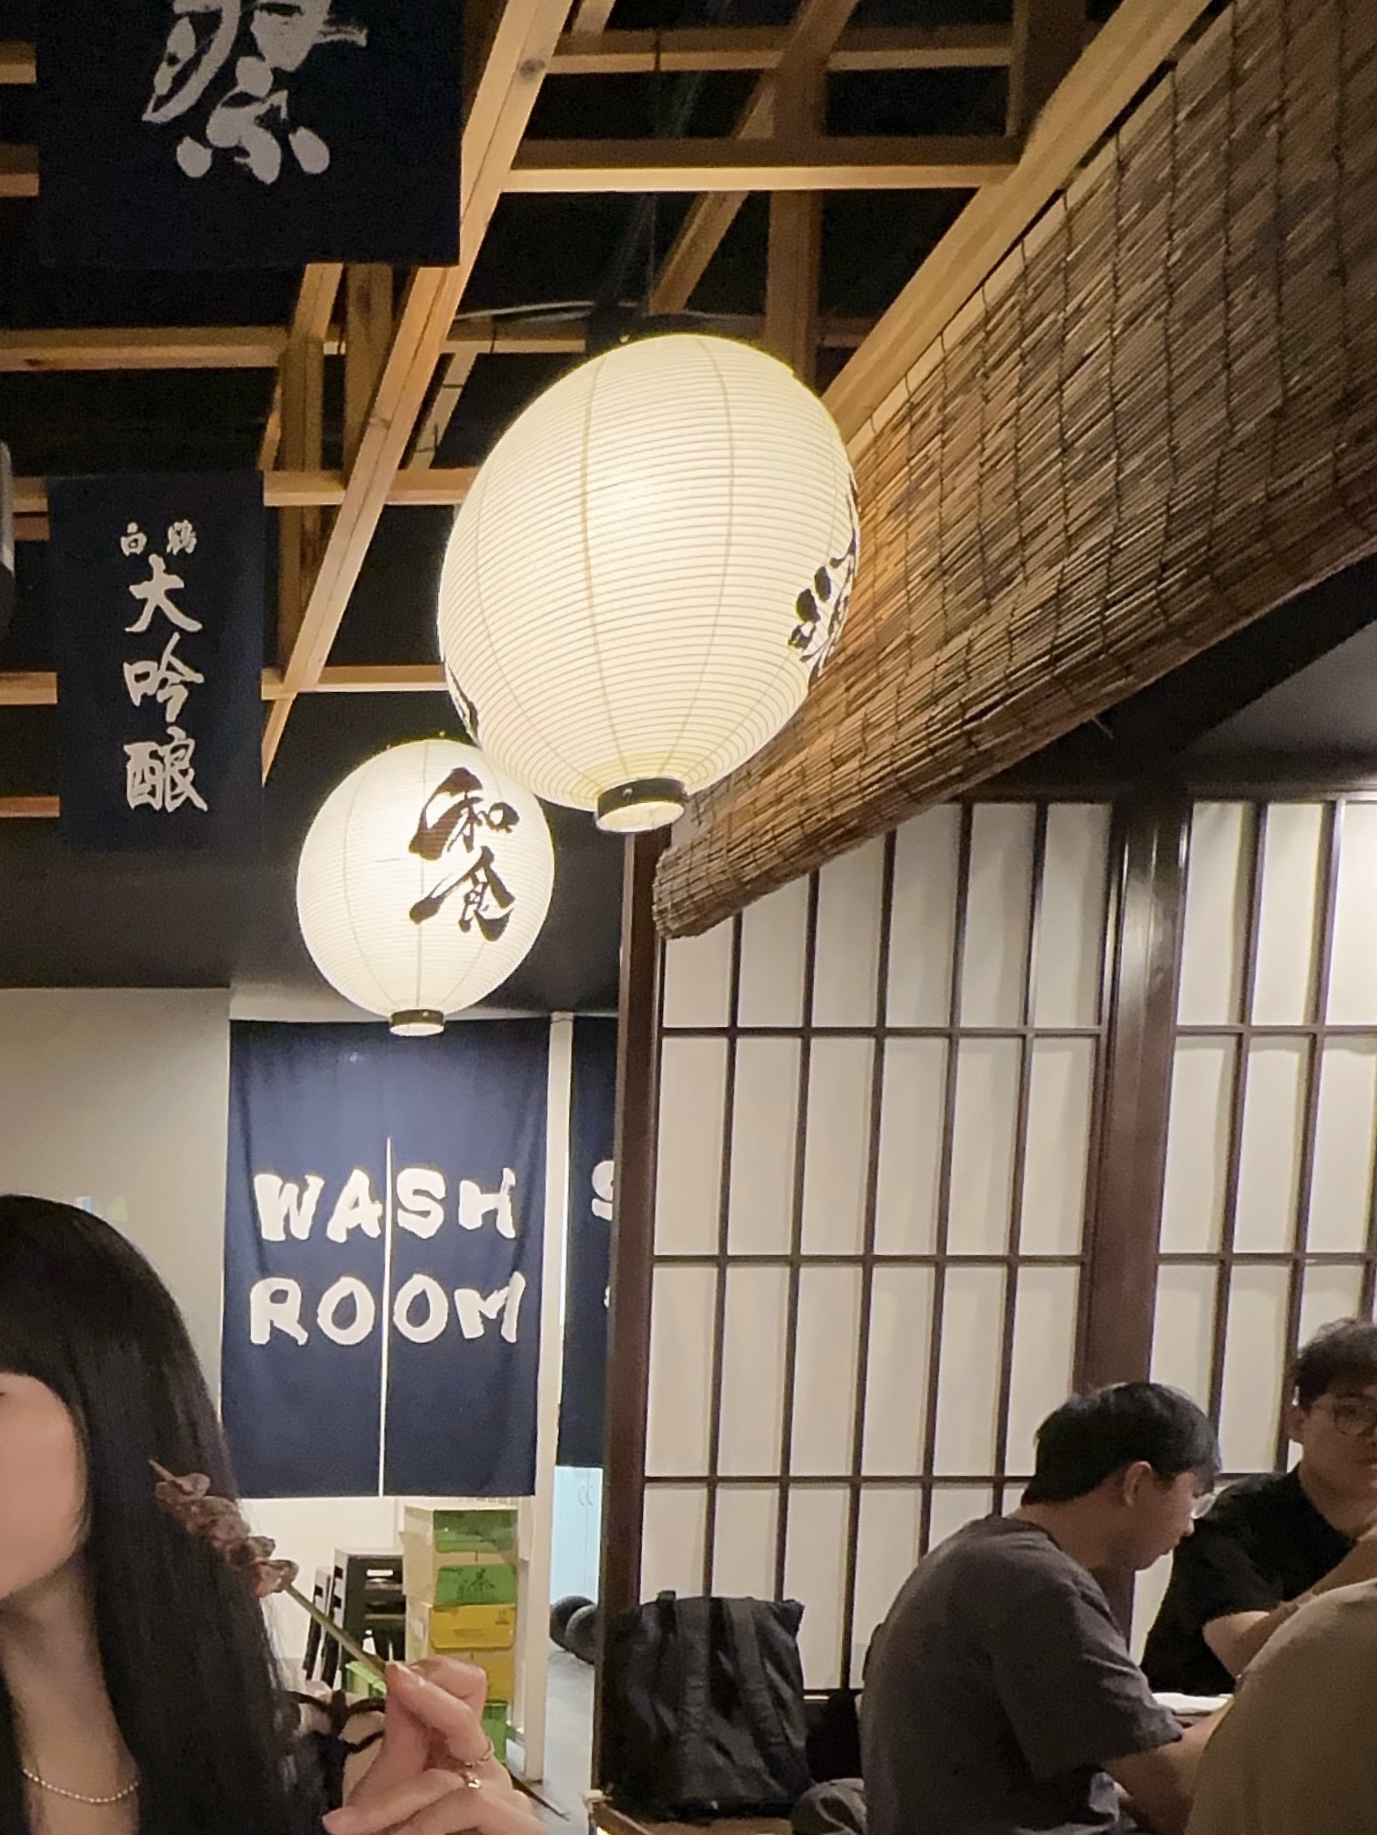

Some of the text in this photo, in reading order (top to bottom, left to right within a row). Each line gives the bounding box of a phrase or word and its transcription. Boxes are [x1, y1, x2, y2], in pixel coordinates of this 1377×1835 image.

[409, 767, 520, 942] 和食
[252, 1166, 519, 1244] WASH
[249, 1271, 527, 1347] ROOM
